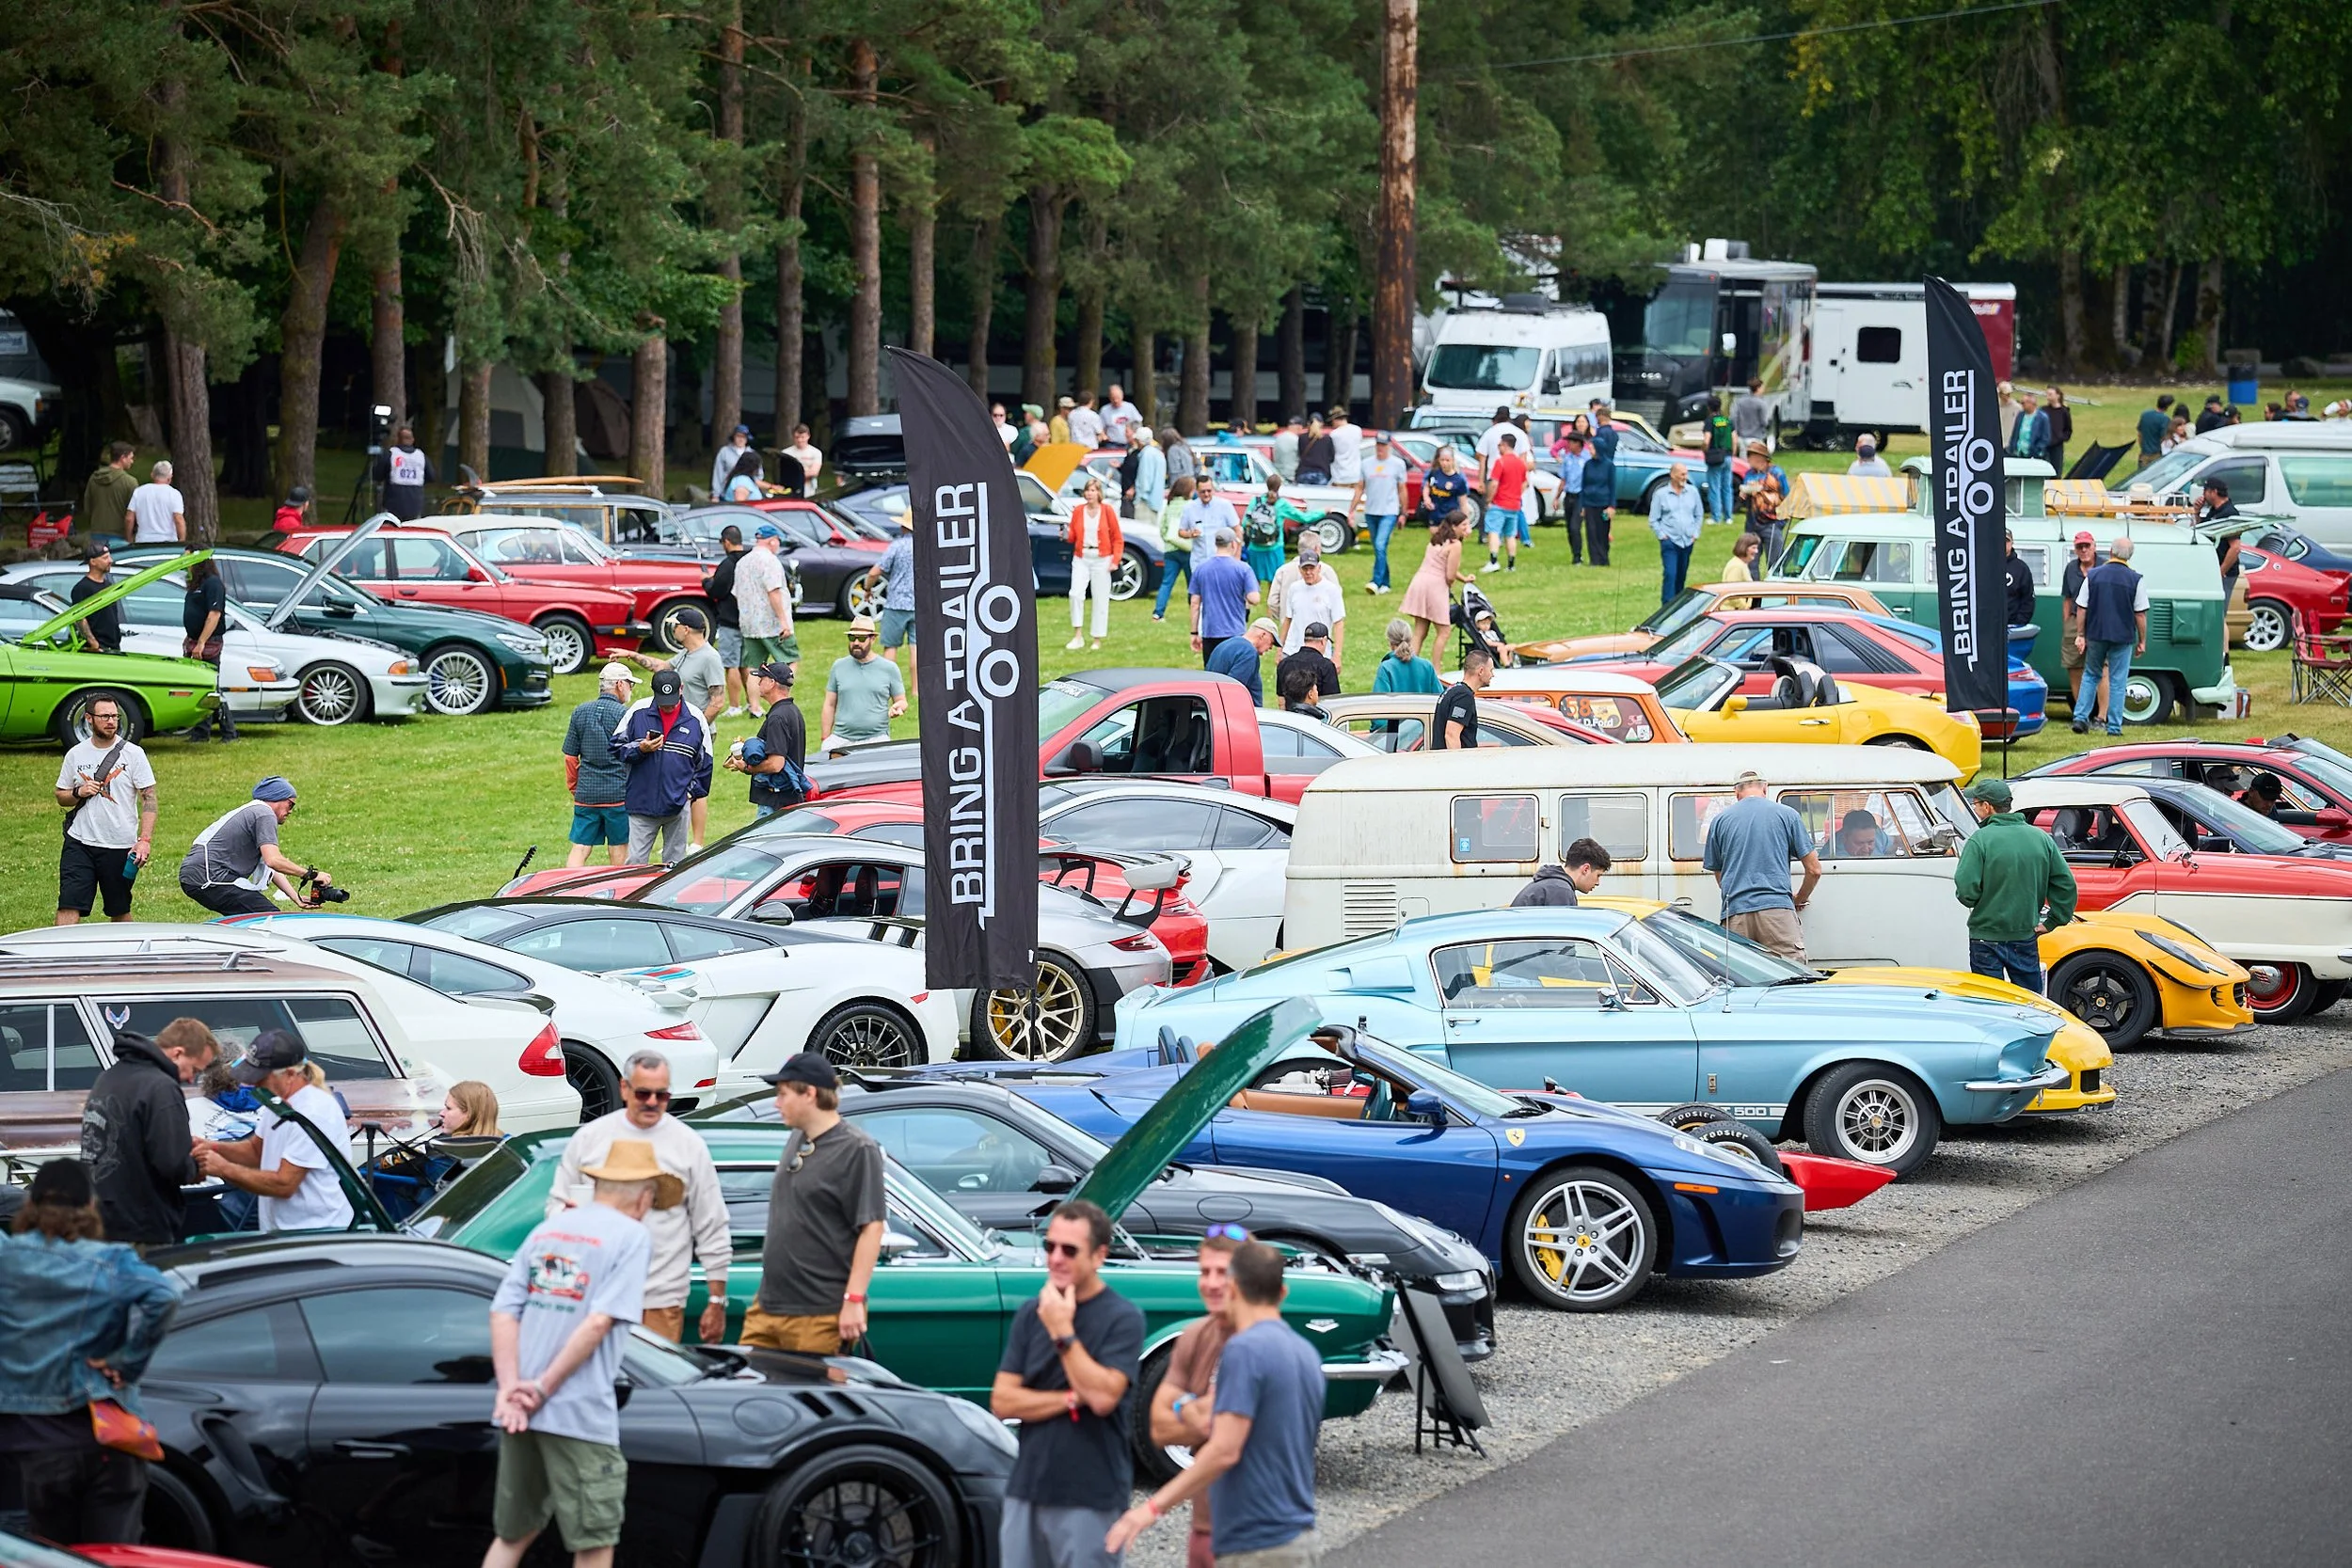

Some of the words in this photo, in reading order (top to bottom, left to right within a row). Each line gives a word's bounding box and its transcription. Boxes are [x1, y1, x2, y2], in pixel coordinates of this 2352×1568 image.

[1944, 370, 1966, 510] TRAILER
[1947, 516, 1966, 539] A
[935, 483, 976, 690] TRAILER
[1947, 547, 1970, 656] BRING
[947, 699, 981, 732] A
[1565, 697, 1592, 718] 58
[1583, 718, 1613, 728] D.Ford
[949, 746, 984, 905] BRING
[1734, 1106, 1767, 1117] 500
